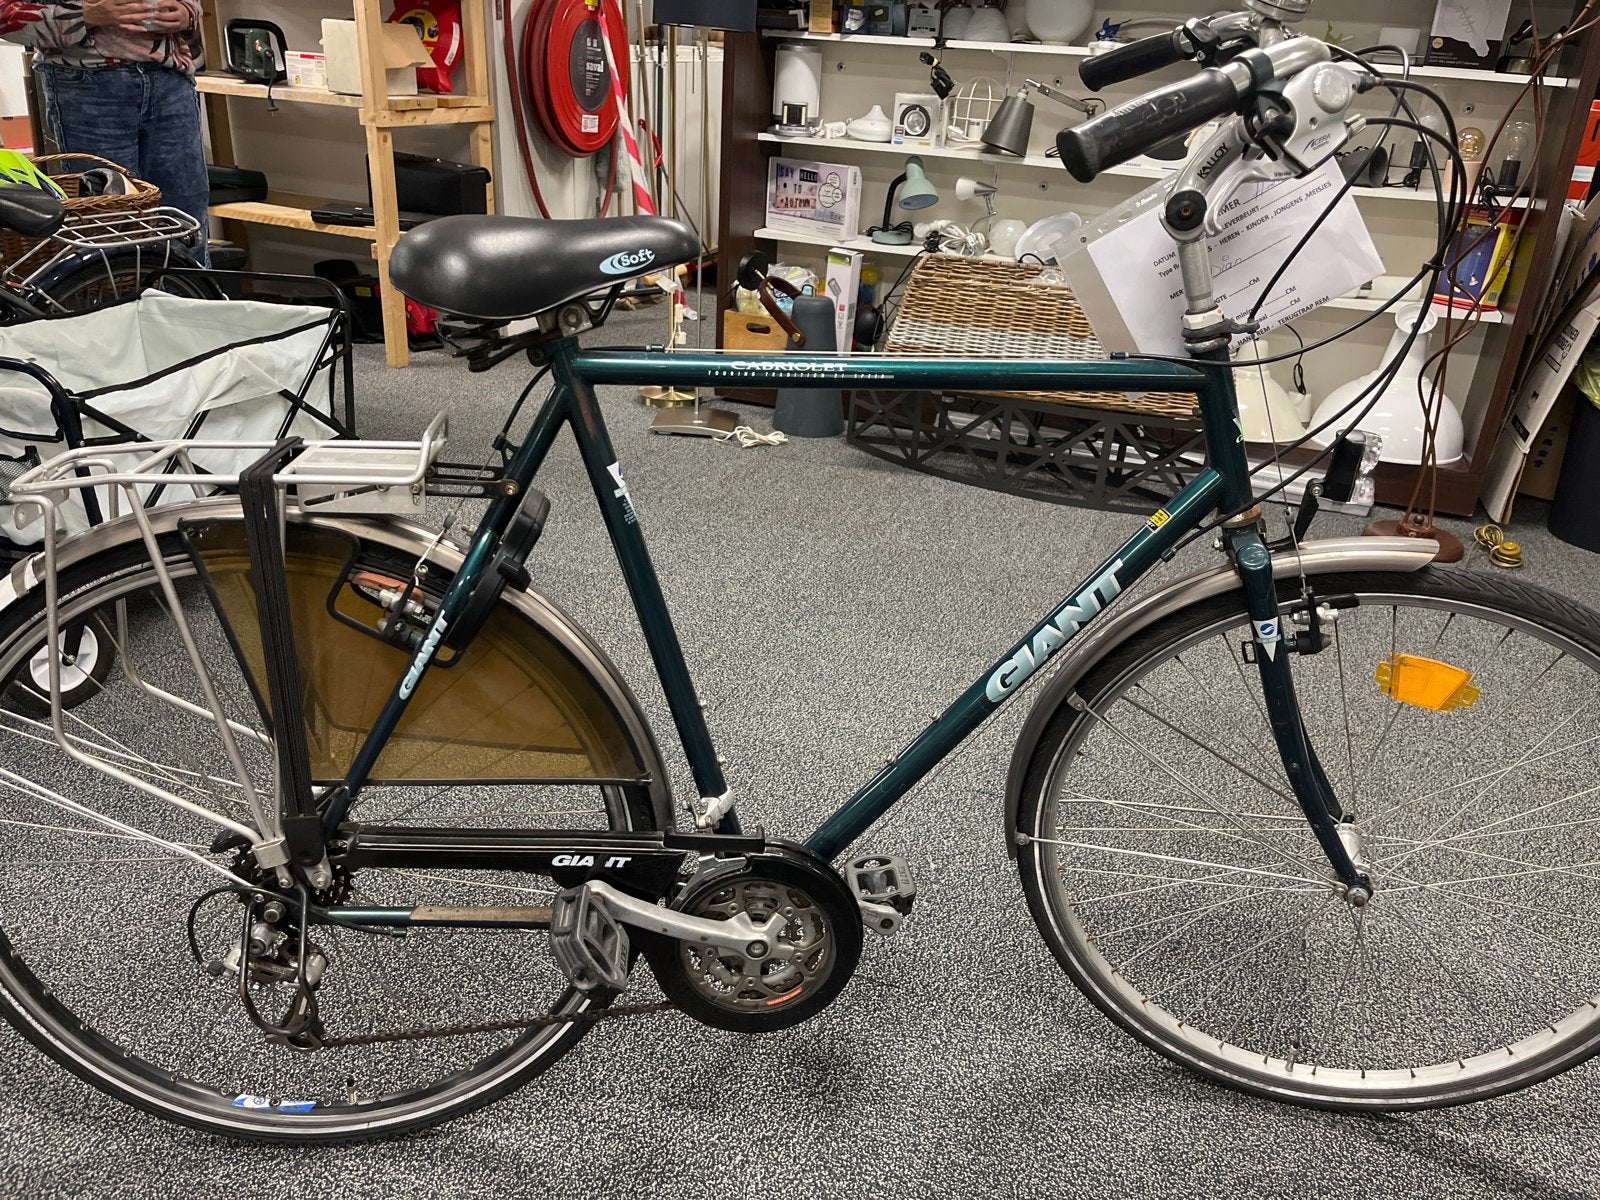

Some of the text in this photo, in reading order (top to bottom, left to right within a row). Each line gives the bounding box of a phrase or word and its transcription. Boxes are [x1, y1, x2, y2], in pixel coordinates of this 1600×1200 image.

[585, 60, 604, 73] saval
[1197, 142, 1231, 179] KALLOY
[780, 166, 795, 179] SAY
[793, 184, 802, 194] TO
[1217, 198, 1241, 216] MER
[1219, 229, 1241, 246] HEREN
[1245, 214, 1270, 231] KINDER
[1273, 197, 1303, 217] JONGENS
[620, 248, 653, 267] Soft
[1153, 251, 1176, 267] DATUM
[1158, 266, 1173, 278] Type
[1169, 288, 1184, 301] MER
[1285, 285, 1297, 295] CM
[1290, 297, 1301, 306] CM
[1256, 325, 1271, 336] REM
[1277, 304, 1314, 325] TERUGTRAP
[1315, 296, 1330, 306] REM
[730, 360, 848, 372] CABRIOLET
[765, 371, 825, 379] TRADITION
[984, 557, 1124, 703] GIANT
[399, 609, 448, 700] GIANT
